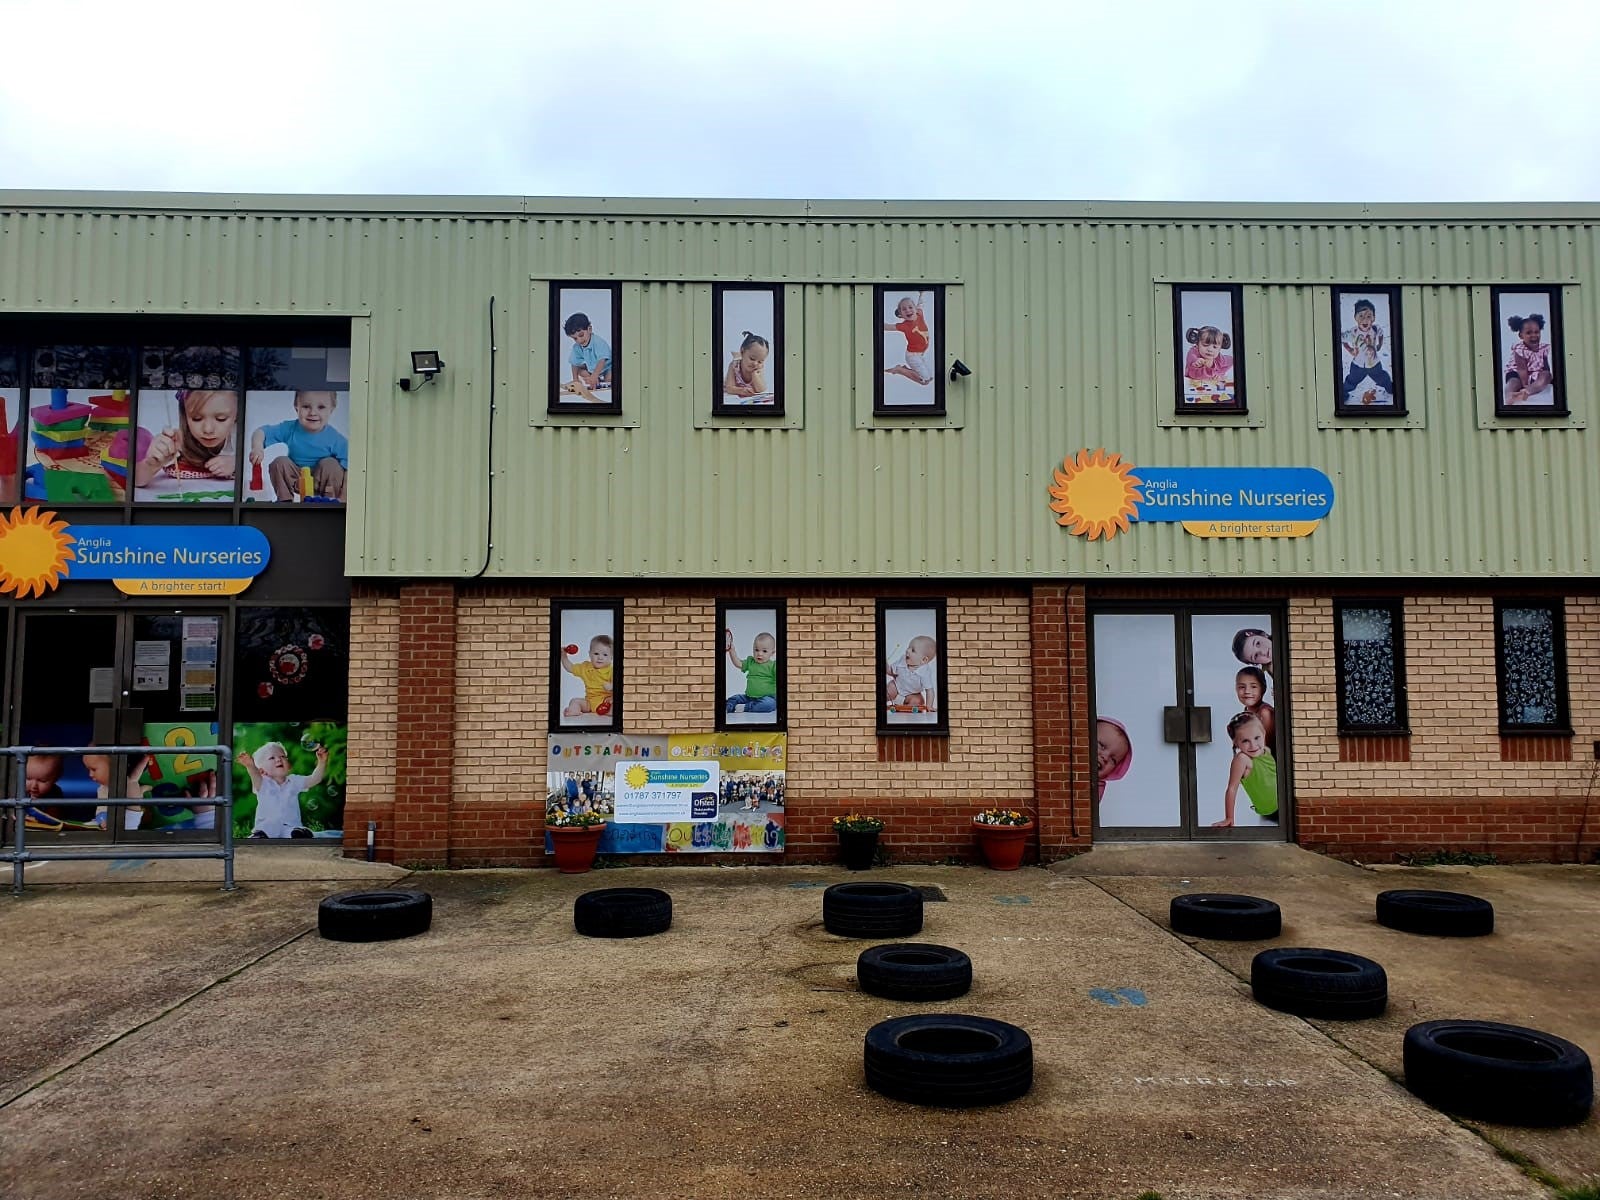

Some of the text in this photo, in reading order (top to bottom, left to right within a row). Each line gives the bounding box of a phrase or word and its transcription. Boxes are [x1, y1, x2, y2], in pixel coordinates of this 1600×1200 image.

[1145, 480, 1178, 491] Anglia
[1145, 489, 1327, 506] Sunshine Nurseries
[1209, 523, 1293, 535] A brighter start!
[78, 537, 112, 549] Anglia
[77, 547, 262, 564] Sunshine Nurseries
[140, 581, 226, 593] A brighter start!
[552, 745, 662, 758] OUTSTANDING
[650, 772, 678, 781] Sunshine
[680, 772, 708, 780] Nurseries
[624, 791, 682, 800] 01787 371797
[1243, 1077, 1298, 1087] GAP
